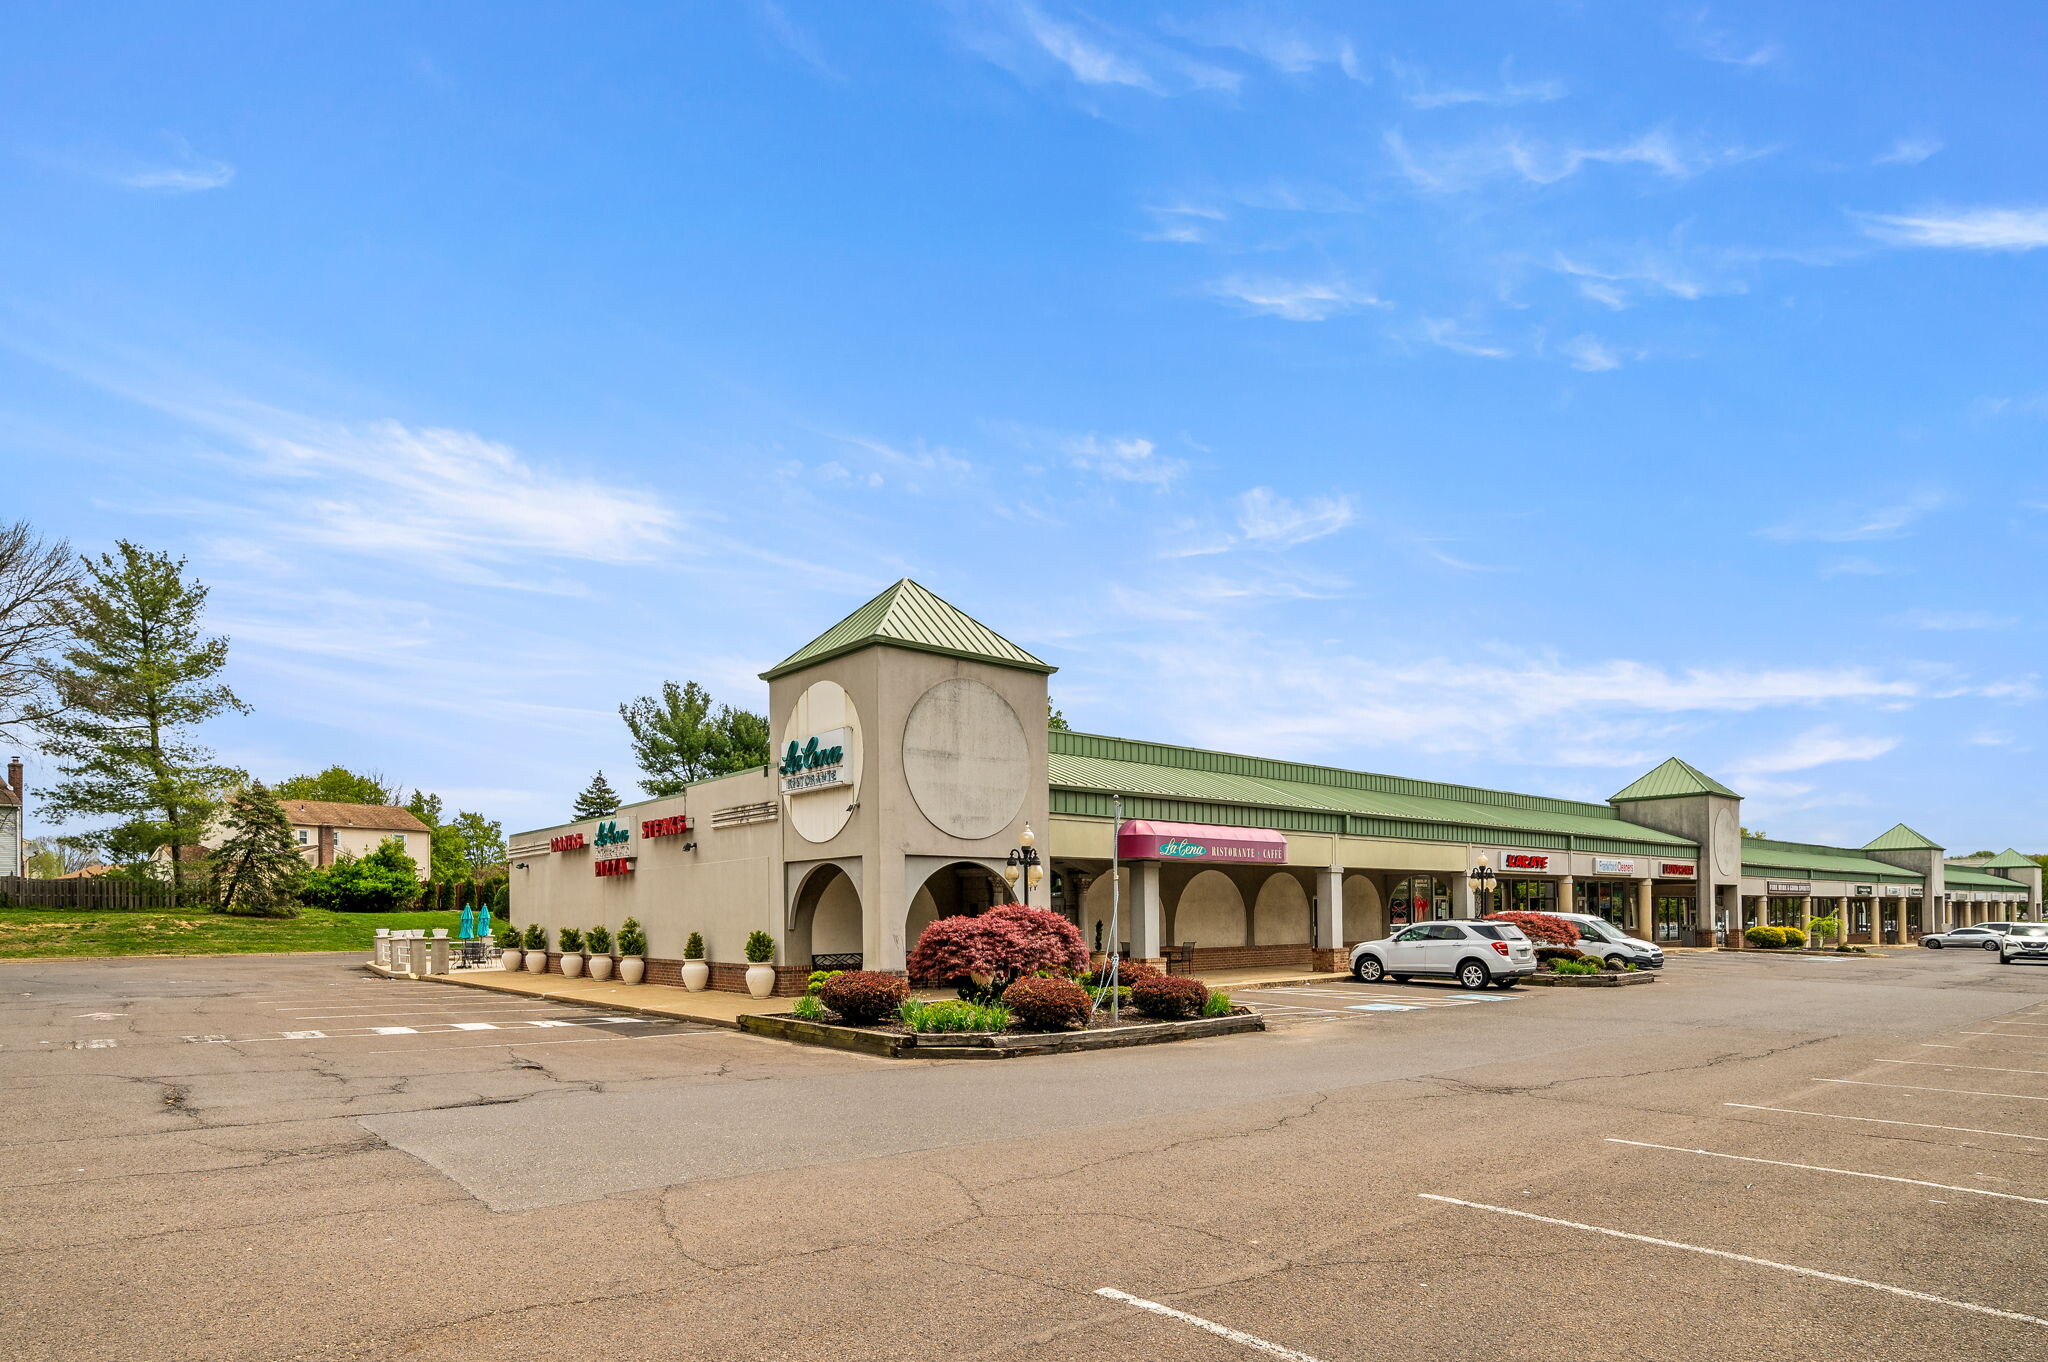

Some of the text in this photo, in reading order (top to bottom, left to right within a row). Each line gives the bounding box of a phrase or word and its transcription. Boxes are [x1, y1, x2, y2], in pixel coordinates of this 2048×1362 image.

[801, 737, 843, 769] Cena
[786, 769, 837, 790] RISTORANTE
[641, 815, 687, 839] STEAKS
[1159, 838, 1180, 856] La
[1179, 838, 1204, 856] Cena
[1211, 846, 1255, 858] RISTORANTE
[595, 858, 629, 877] PIZZA
[1506, 854, 1548, 869] KARATE
